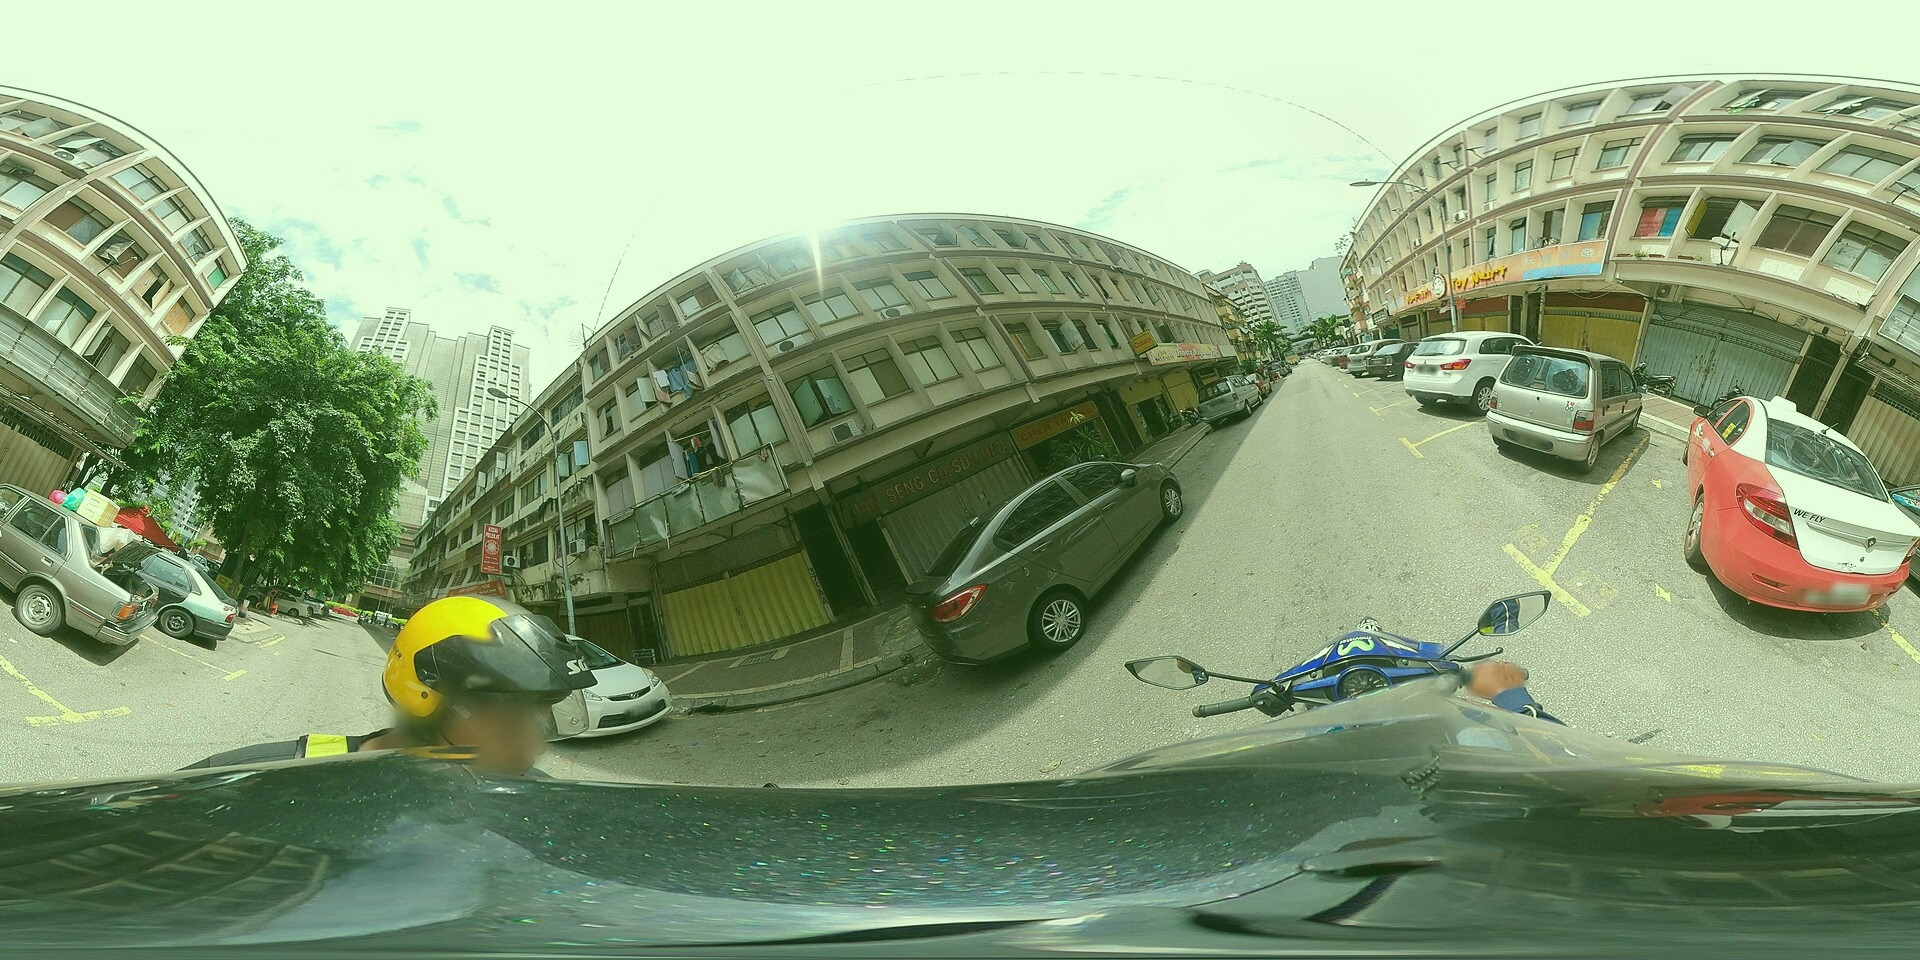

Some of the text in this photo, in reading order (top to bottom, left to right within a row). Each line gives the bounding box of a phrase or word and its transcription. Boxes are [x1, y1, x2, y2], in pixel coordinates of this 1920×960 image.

[885, 475, 924, 504] SENG
[1794, 508, 1826, 523] WE FLY
